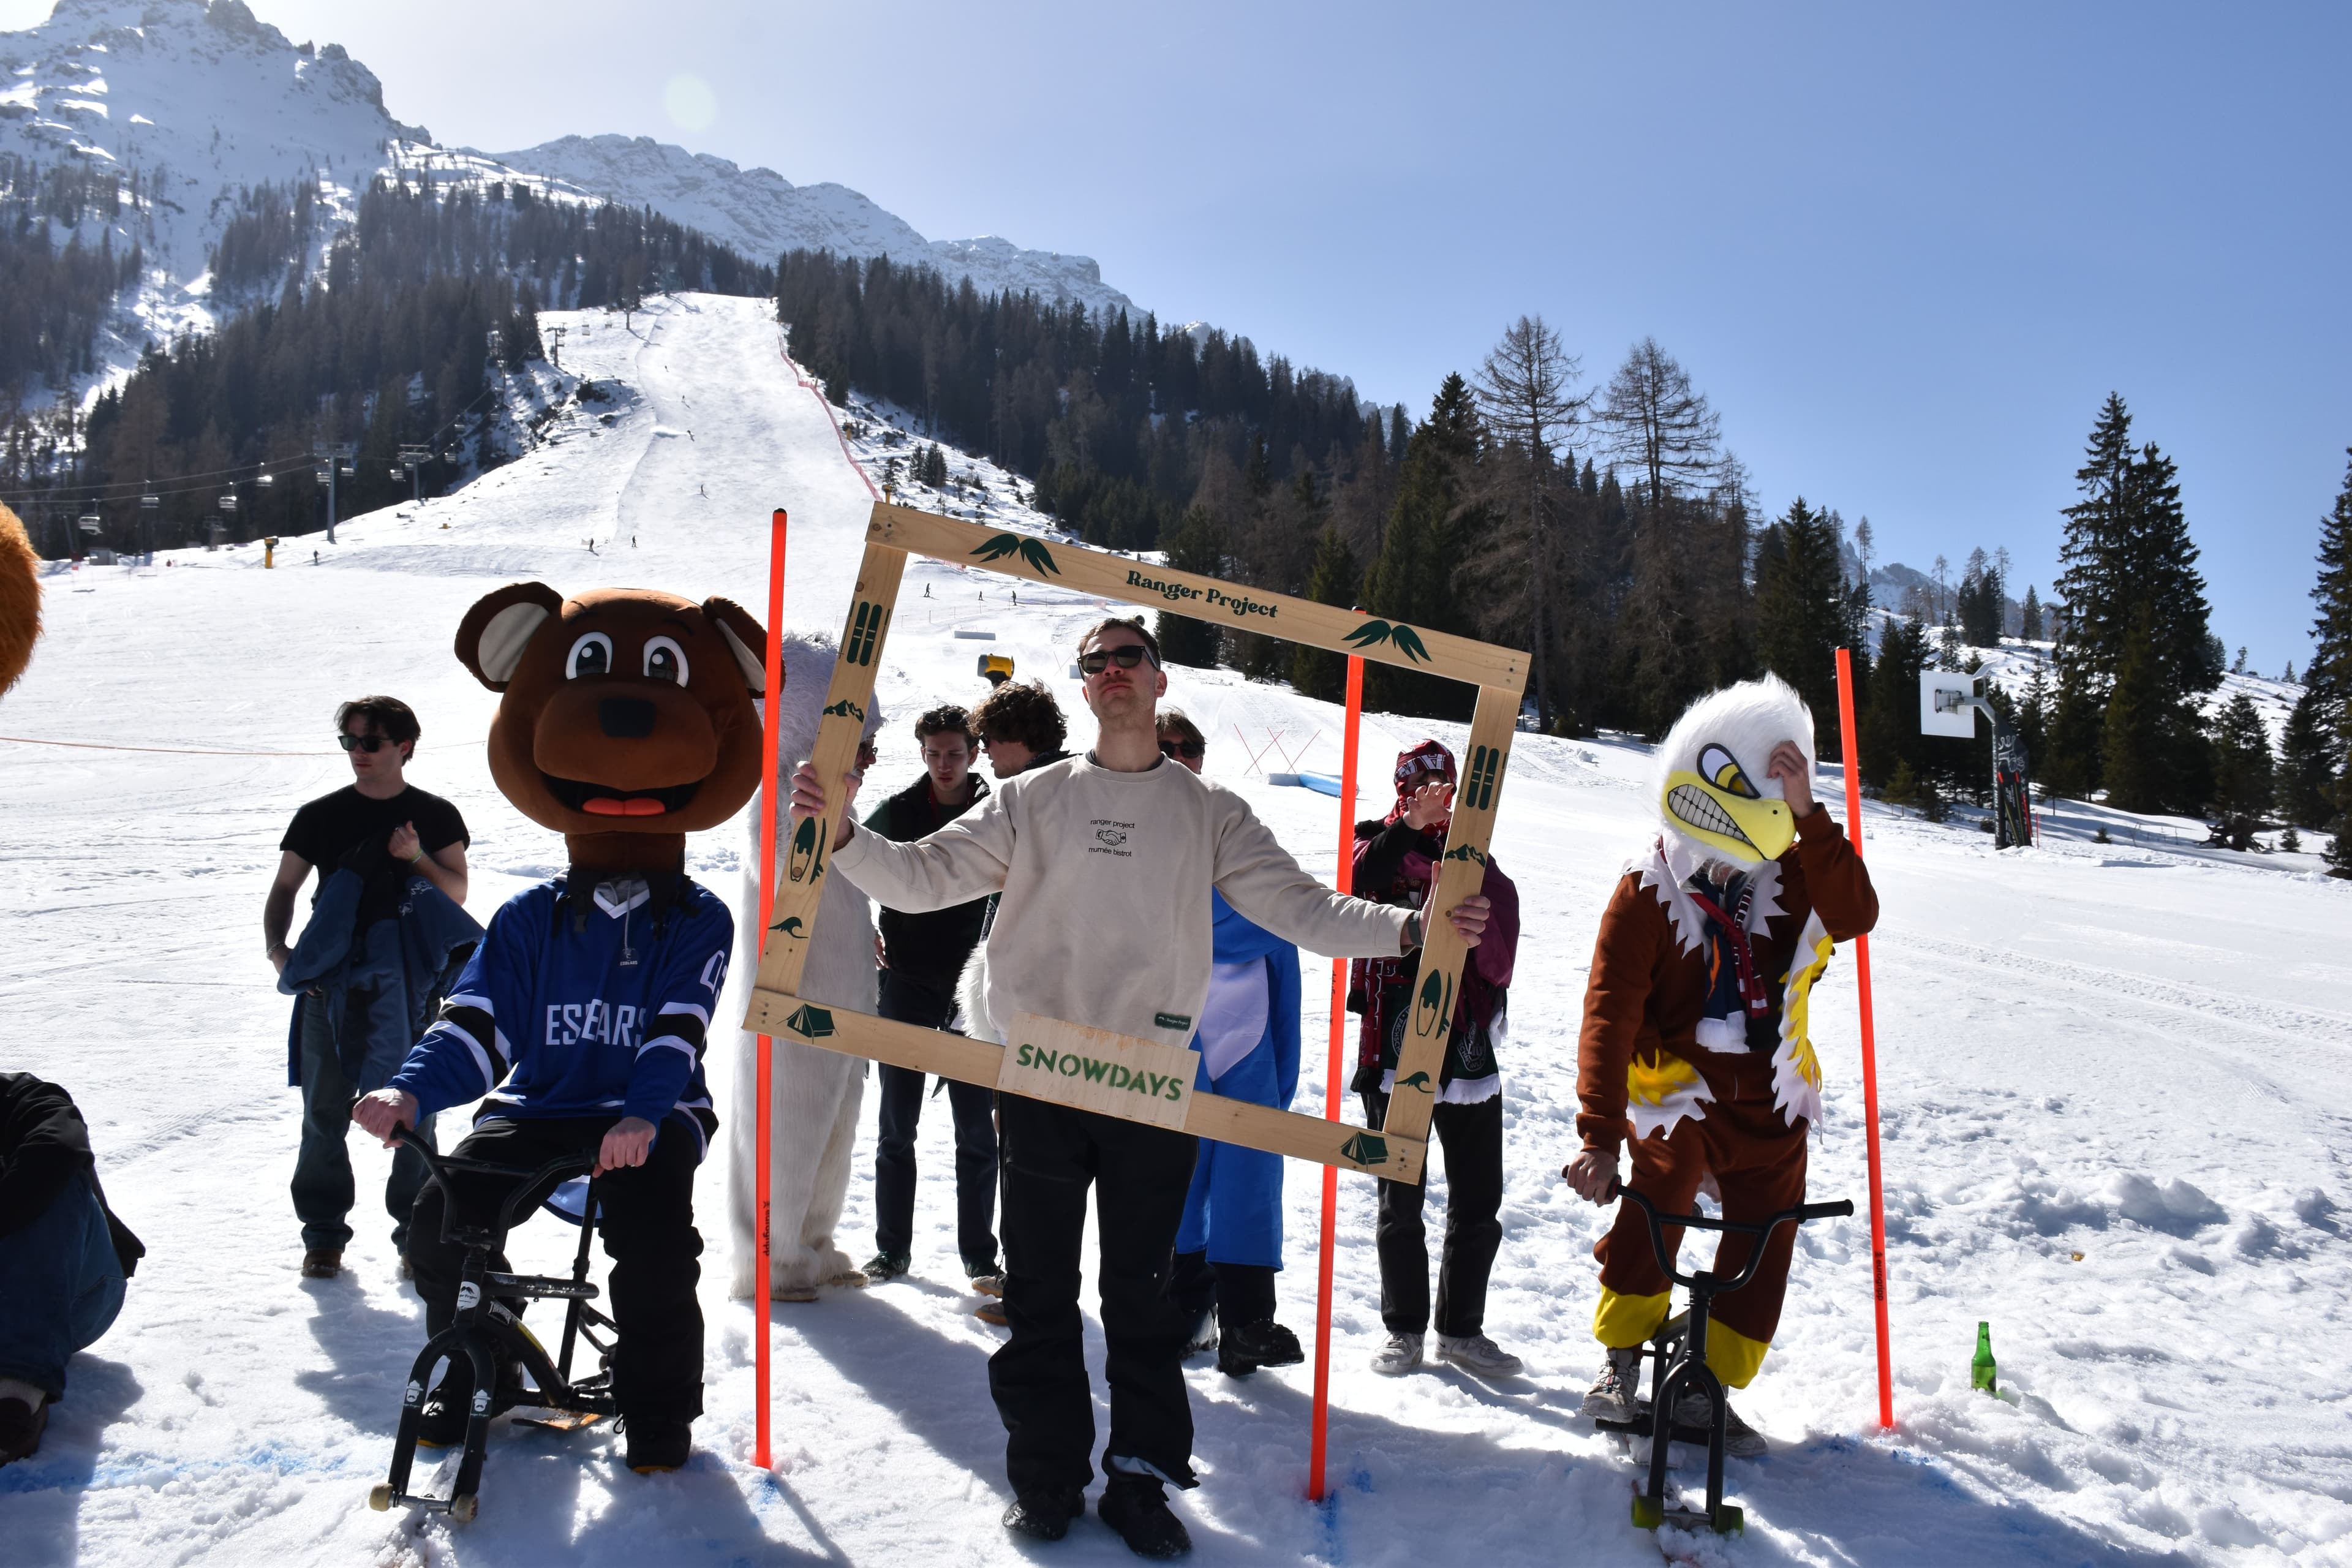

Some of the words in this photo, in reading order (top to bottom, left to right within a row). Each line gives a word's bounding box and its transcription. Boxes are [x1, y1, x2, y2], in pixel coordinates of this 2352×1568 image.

[1126, 570, 1203, 601] Ranger
[1205, 587, 1278, 618] Project
[1112, 821, 1135, 829] project
[1113, 848, 1132, 857] bistrot
[1016, 1043, 1184, 1101] SNOWDAYS
[1875, 1259, 1885, 1302] eurogripp
